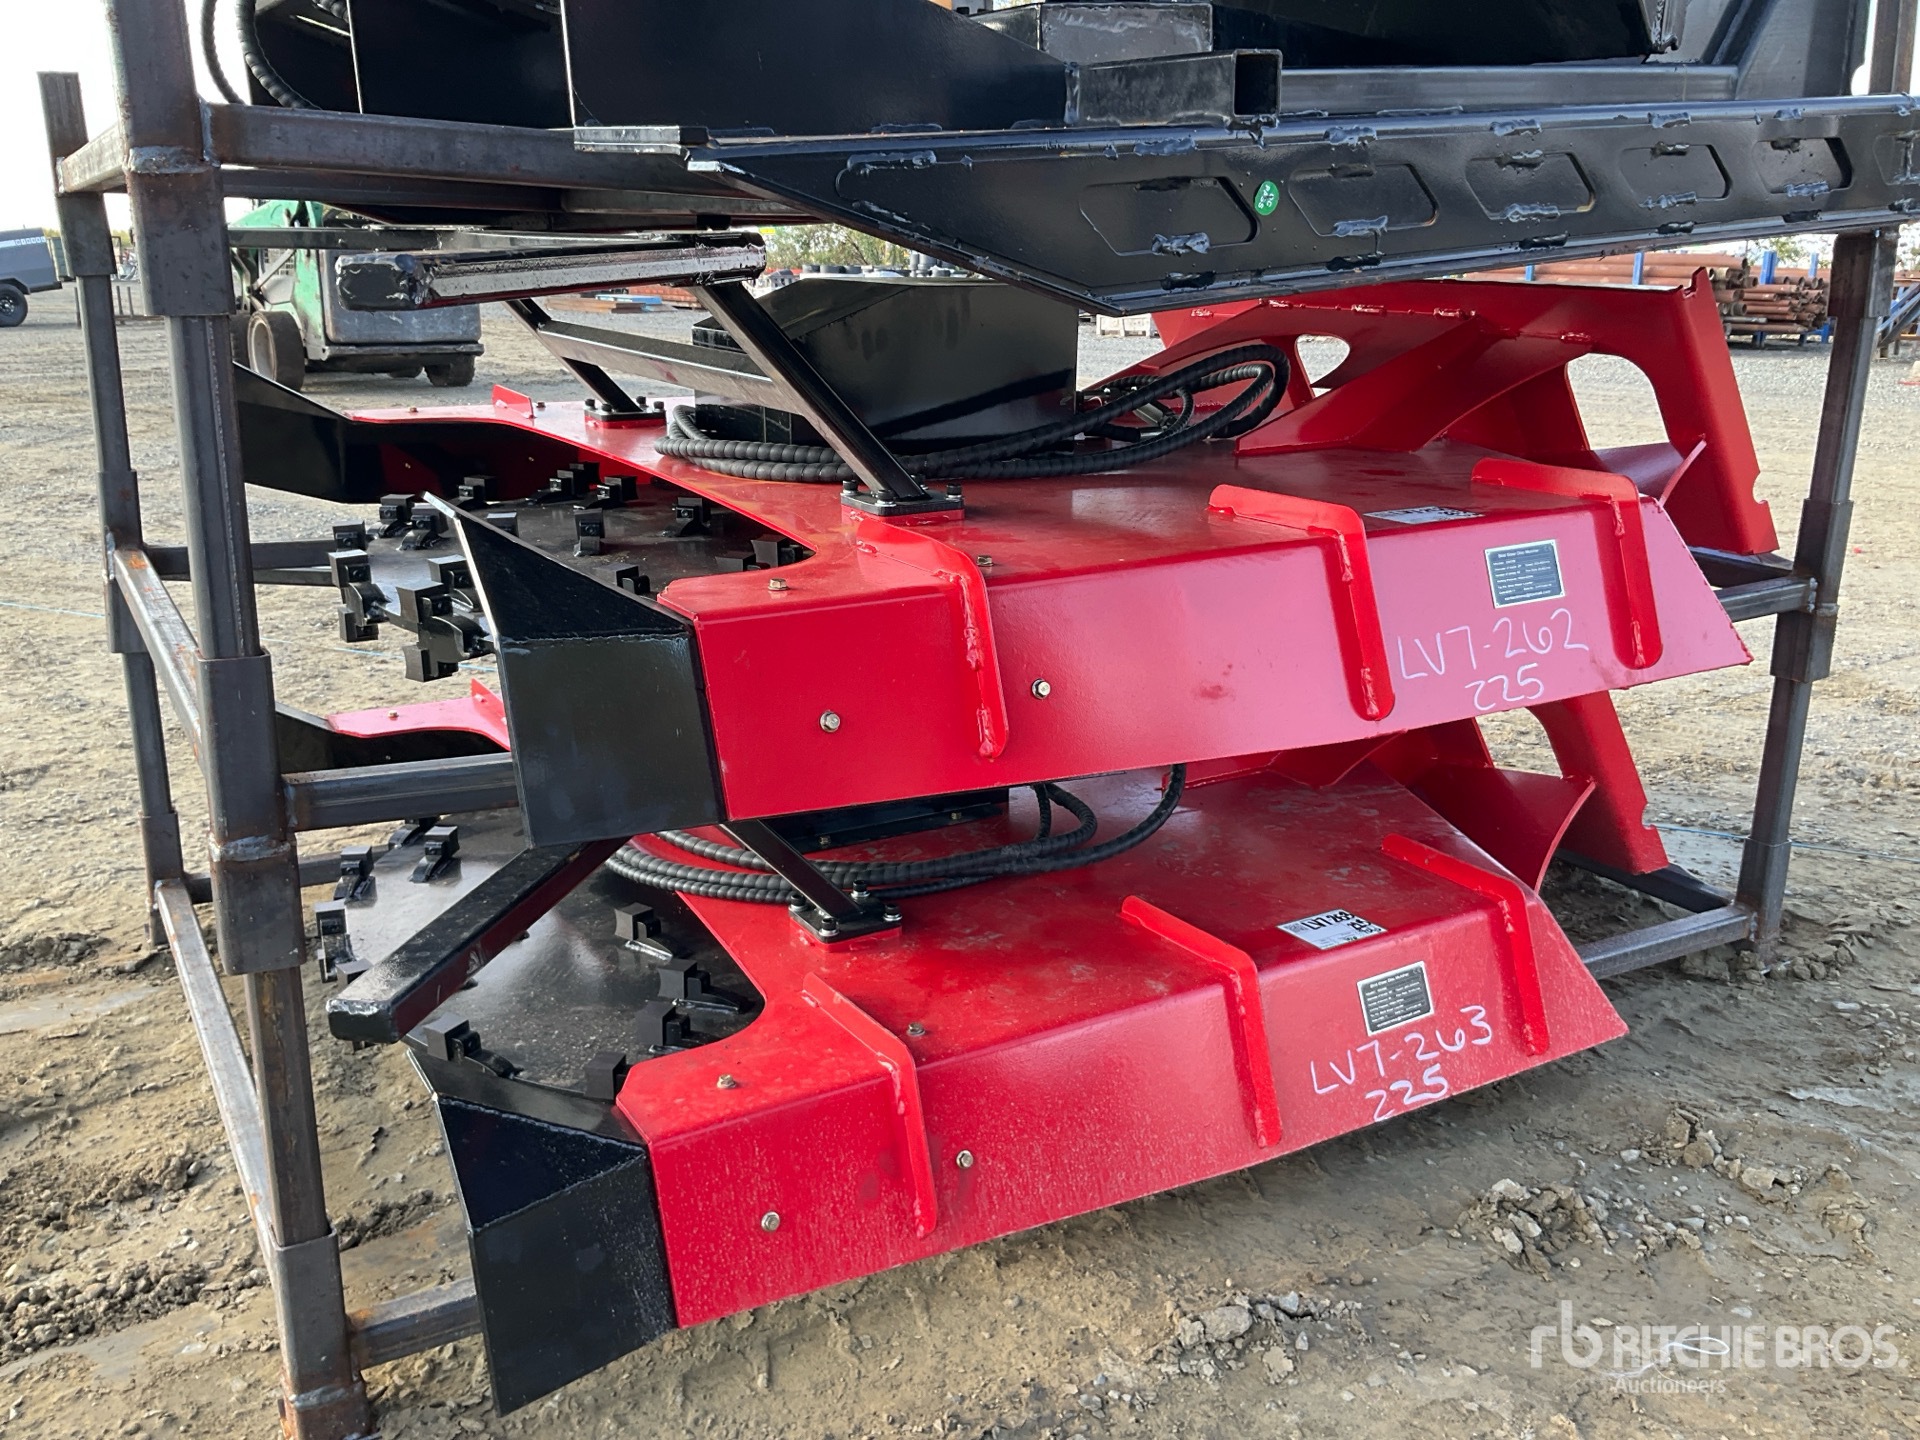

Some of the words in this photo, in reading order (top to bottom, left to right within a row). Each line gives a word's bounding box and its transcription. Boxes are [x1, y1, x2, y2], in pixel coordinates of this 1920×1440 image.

[1397, 607, 1590, 680] LV7-262
[1464, 662, 1545, 711] 225
[1310, 1004, 1493, 1095] LV7-263
[1364, 1063, 1449, 1123] 225
